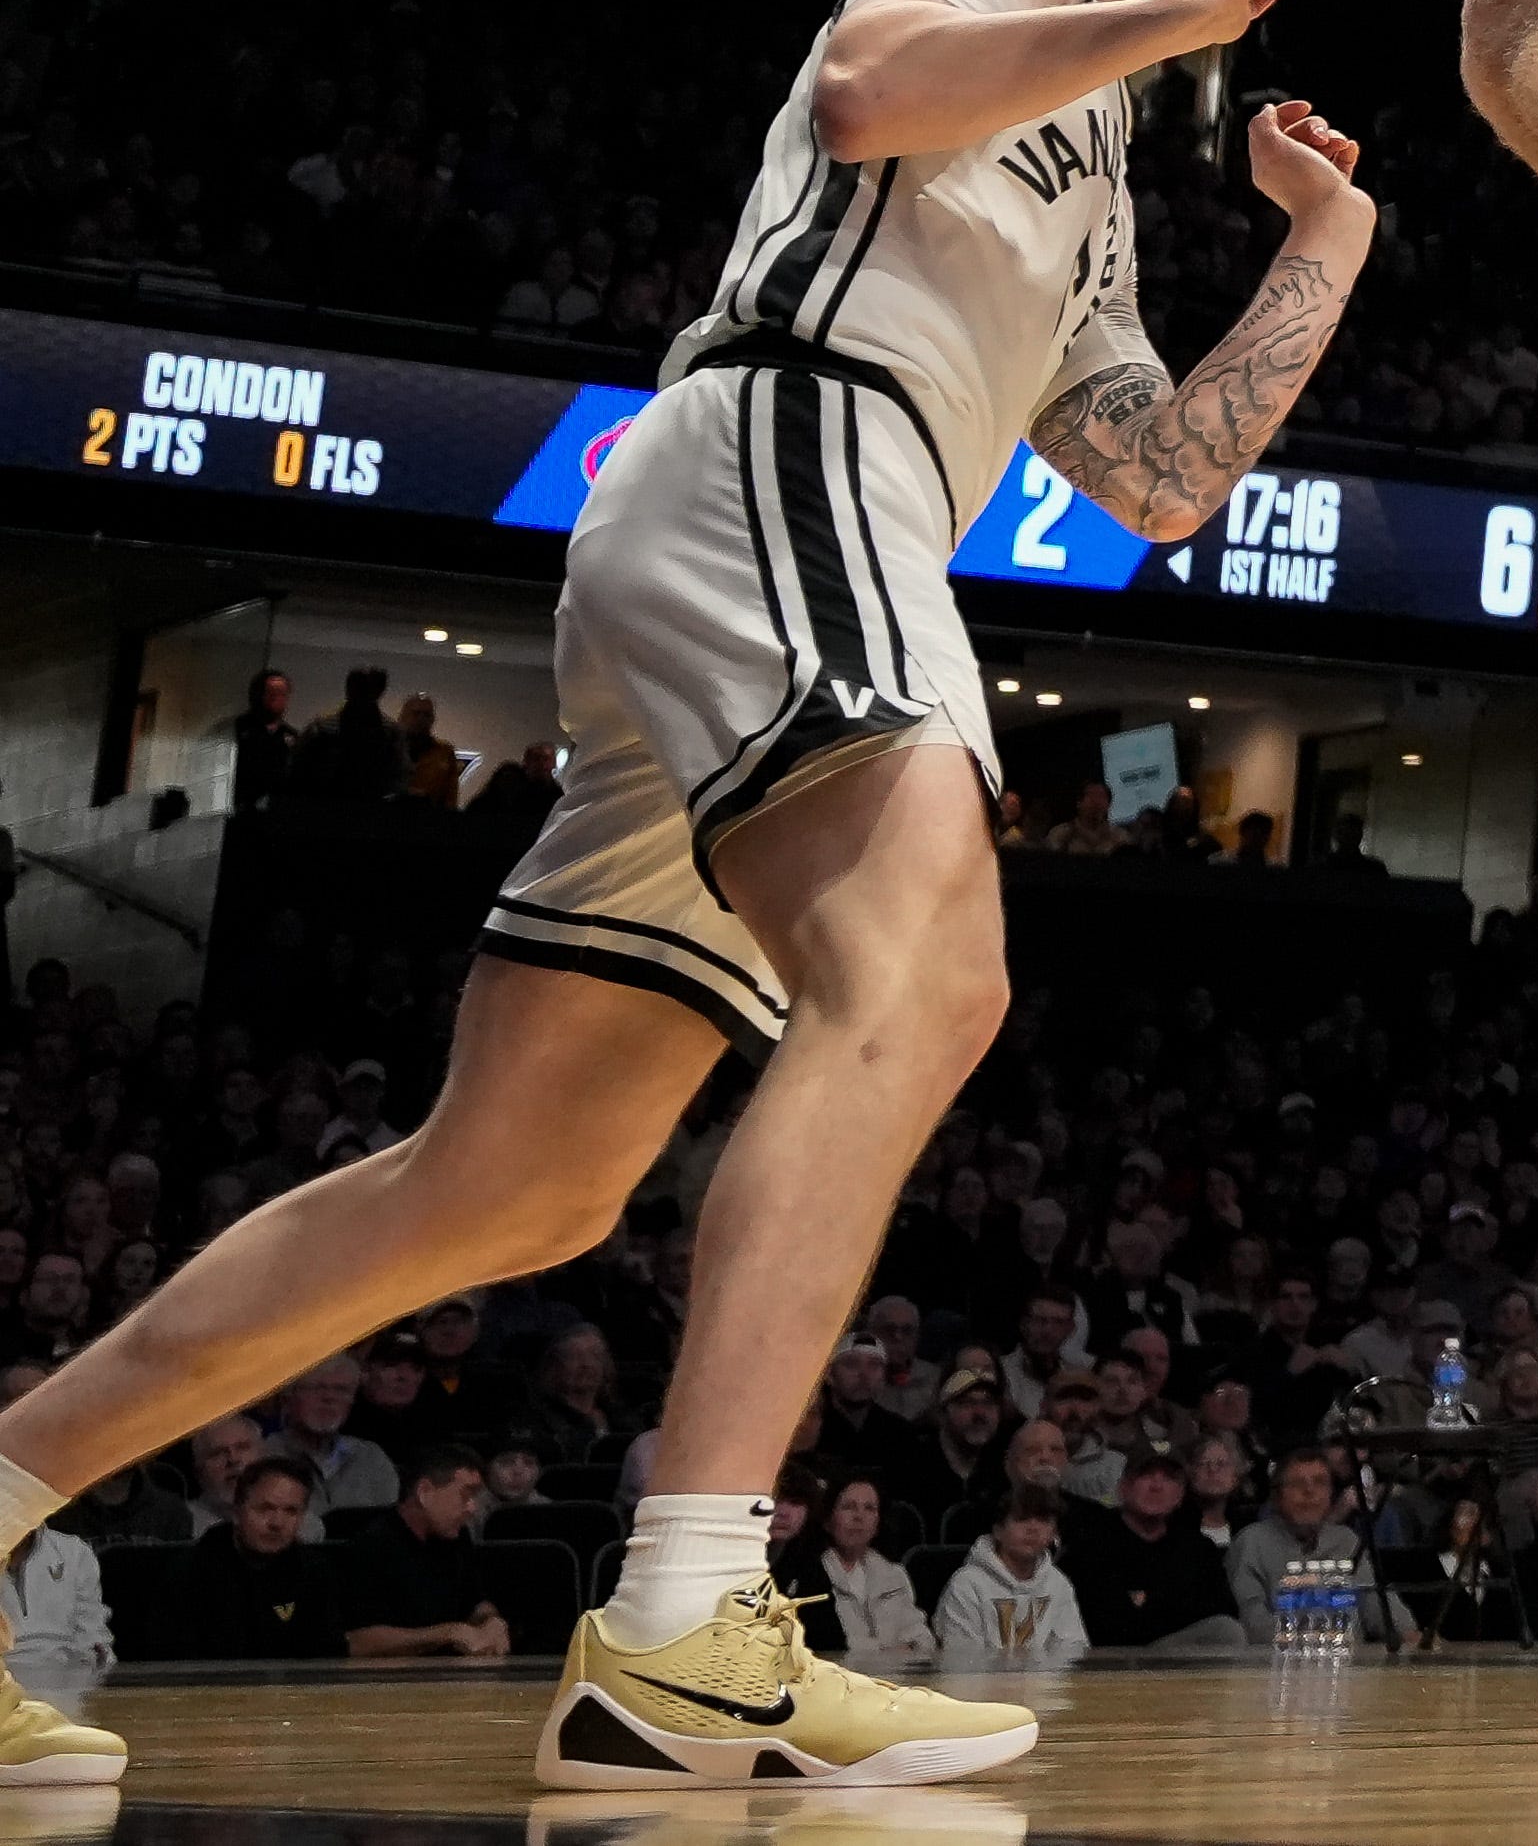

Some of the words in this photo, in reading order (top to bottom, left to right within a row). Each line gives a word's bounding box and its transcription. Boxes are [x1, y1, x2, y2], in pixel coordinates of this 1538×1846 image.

[143, 351, 326, 426] CONDON
[82, 408, 117, 466] 2
[121, 412, 206, 476] PTS
[273, 430, 305, 487] 0
[310, 434, 383, 496] FLS
[1012, 453, 1074, 571] 2
[1227, 472, 1342, 554] 17:16
[1220, 548, 1266, 596] 1ST
[1267, 554, 1337, 603] HALF
[1480, 505, 1535, 617] 6
[831, 679, 875, 718] V
